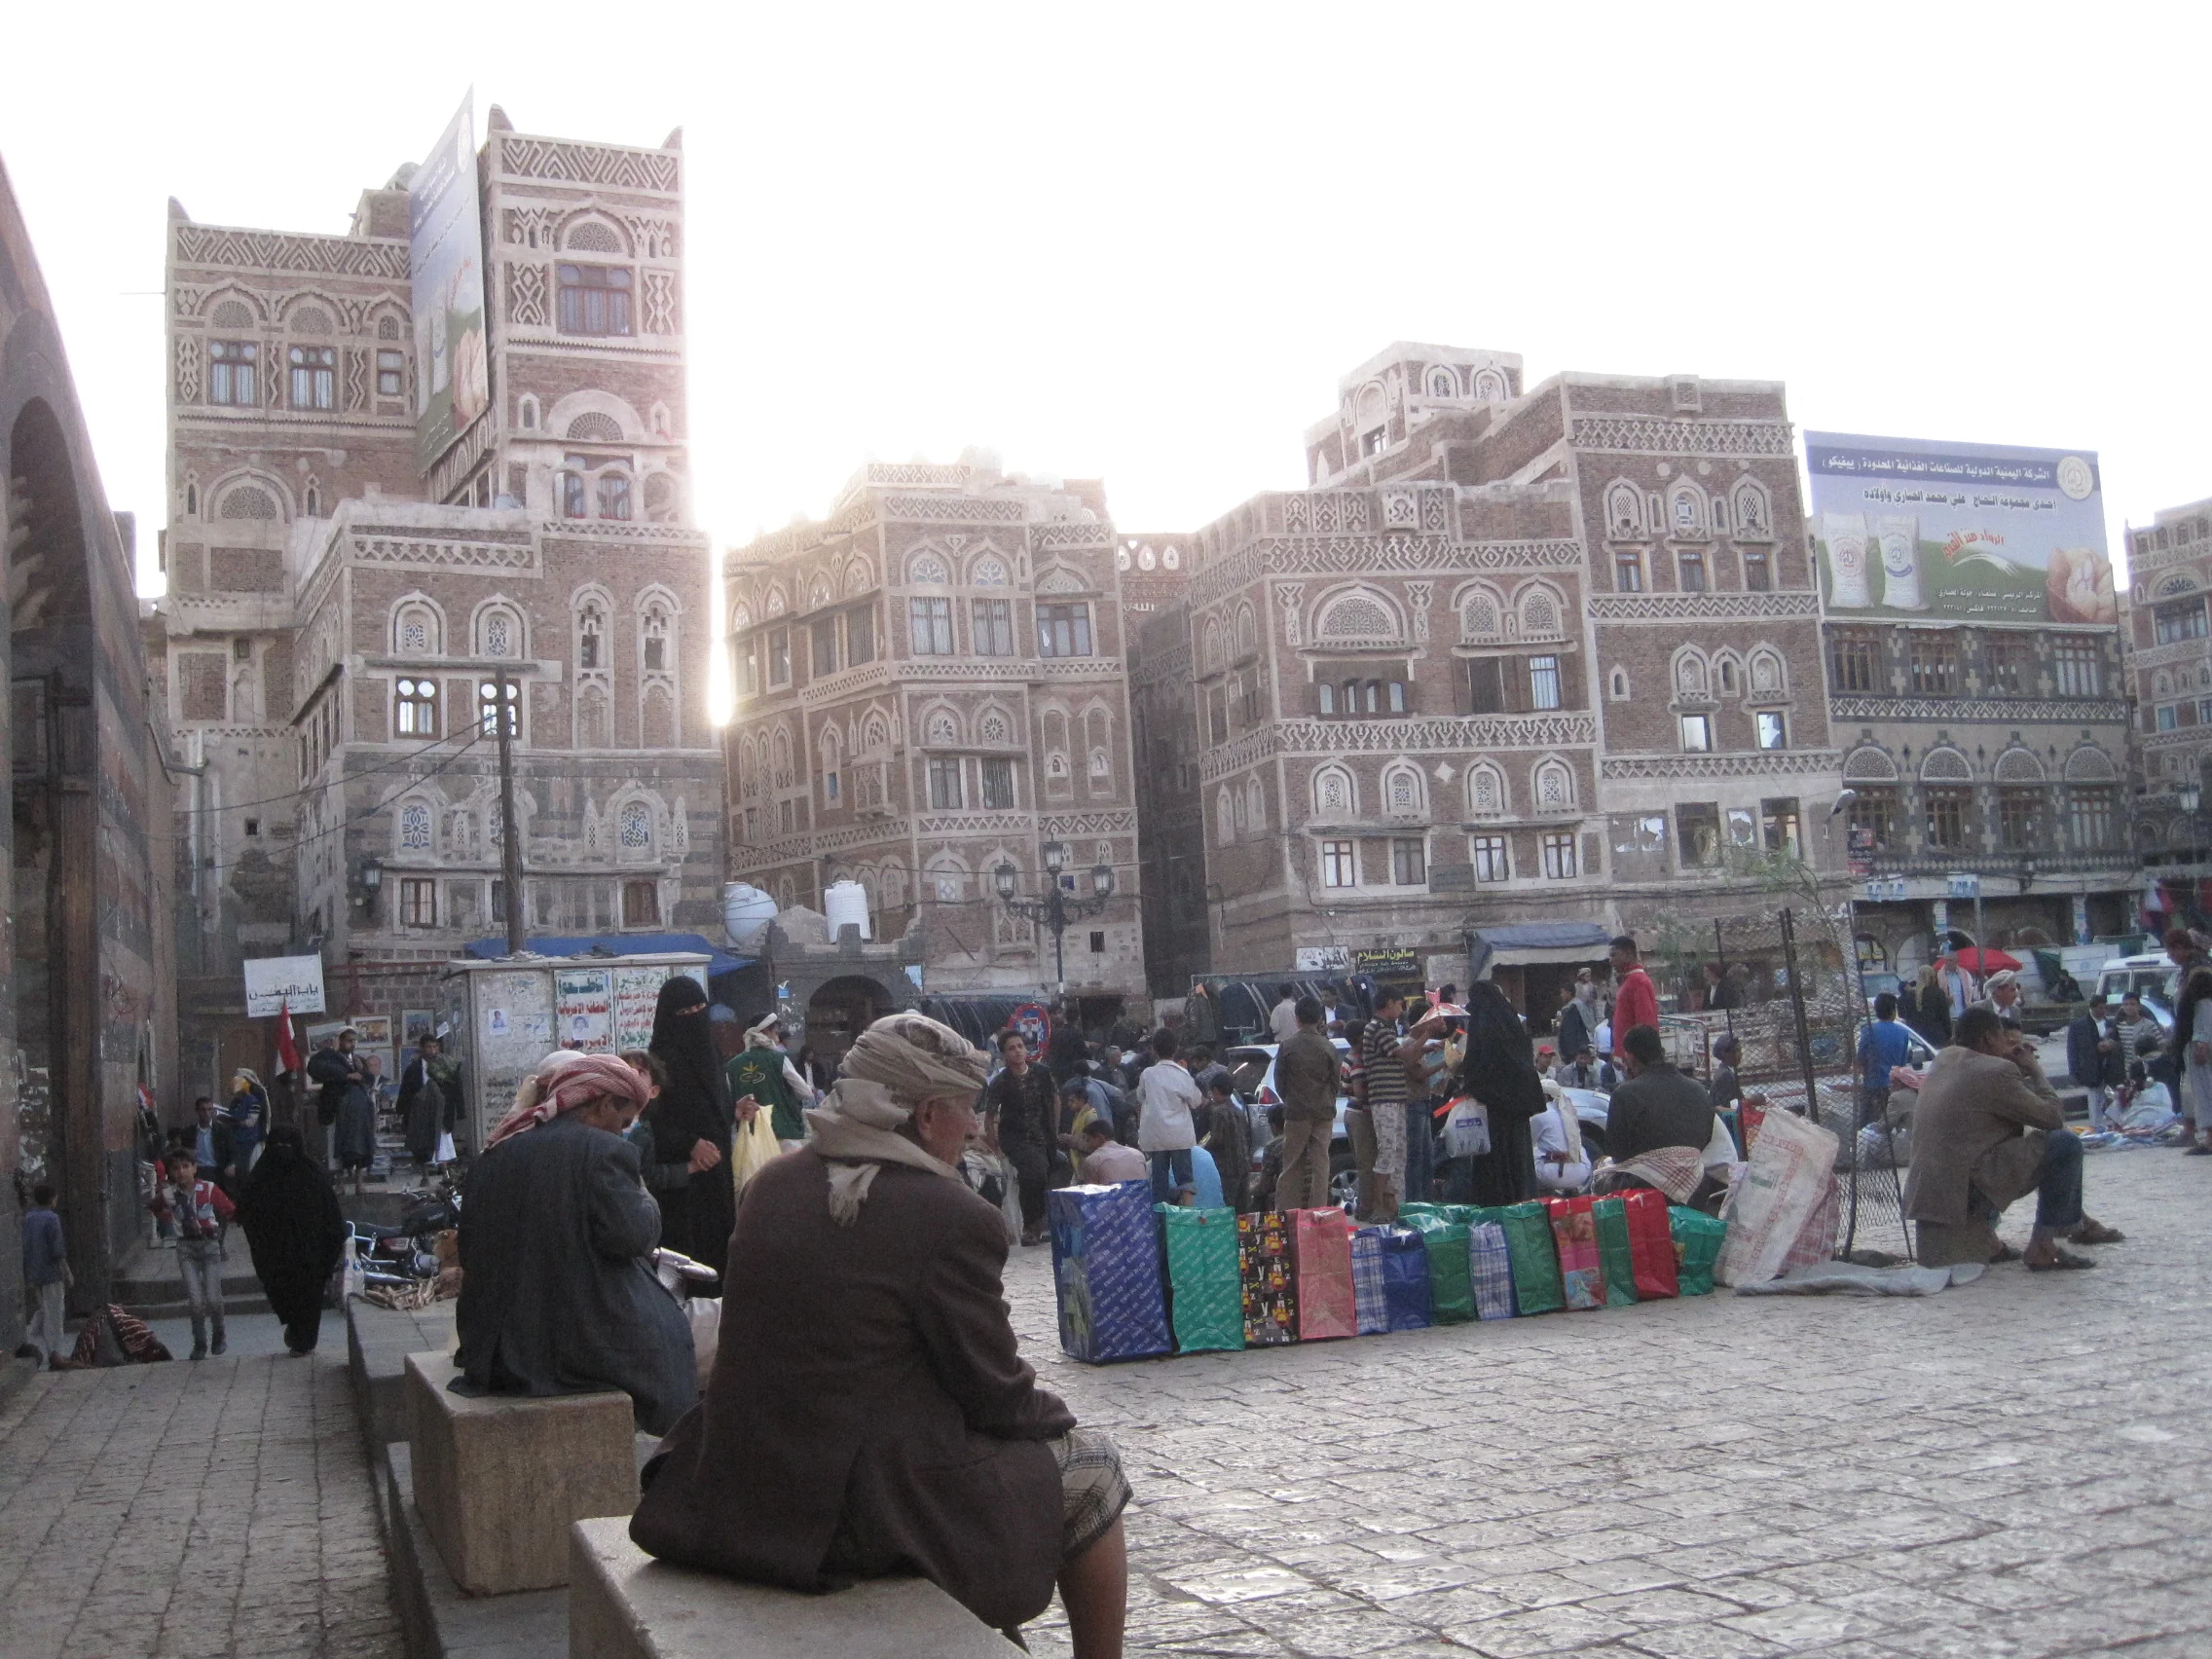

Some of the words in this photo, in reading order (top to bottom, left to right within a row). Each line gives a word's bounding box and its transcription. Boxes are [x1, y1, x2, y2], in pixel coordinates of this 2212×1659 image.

[1862, 457, 1895, 470] المحدودة
[1897, 459, 1928, 472] الغذائية
[1930, 461, 1964, 474] للصناعات
[1966, 463, 1994, 477] الدولية
[1995, 465, 2022, 480] اليمنية
[2023, 466, 2049, 481] الشركة
[1925, 490, 1947, 502] محمد
[1950, 493, 1966, 509] علي
[2000, 495, 2030, 509] مجموعة
[1357, 948, 1389, 966] السلام
[1389, 947, 1415, 961] صالون
[249, 984, 297, 1001] اليمن
[298, 982, 318, 998] باب
